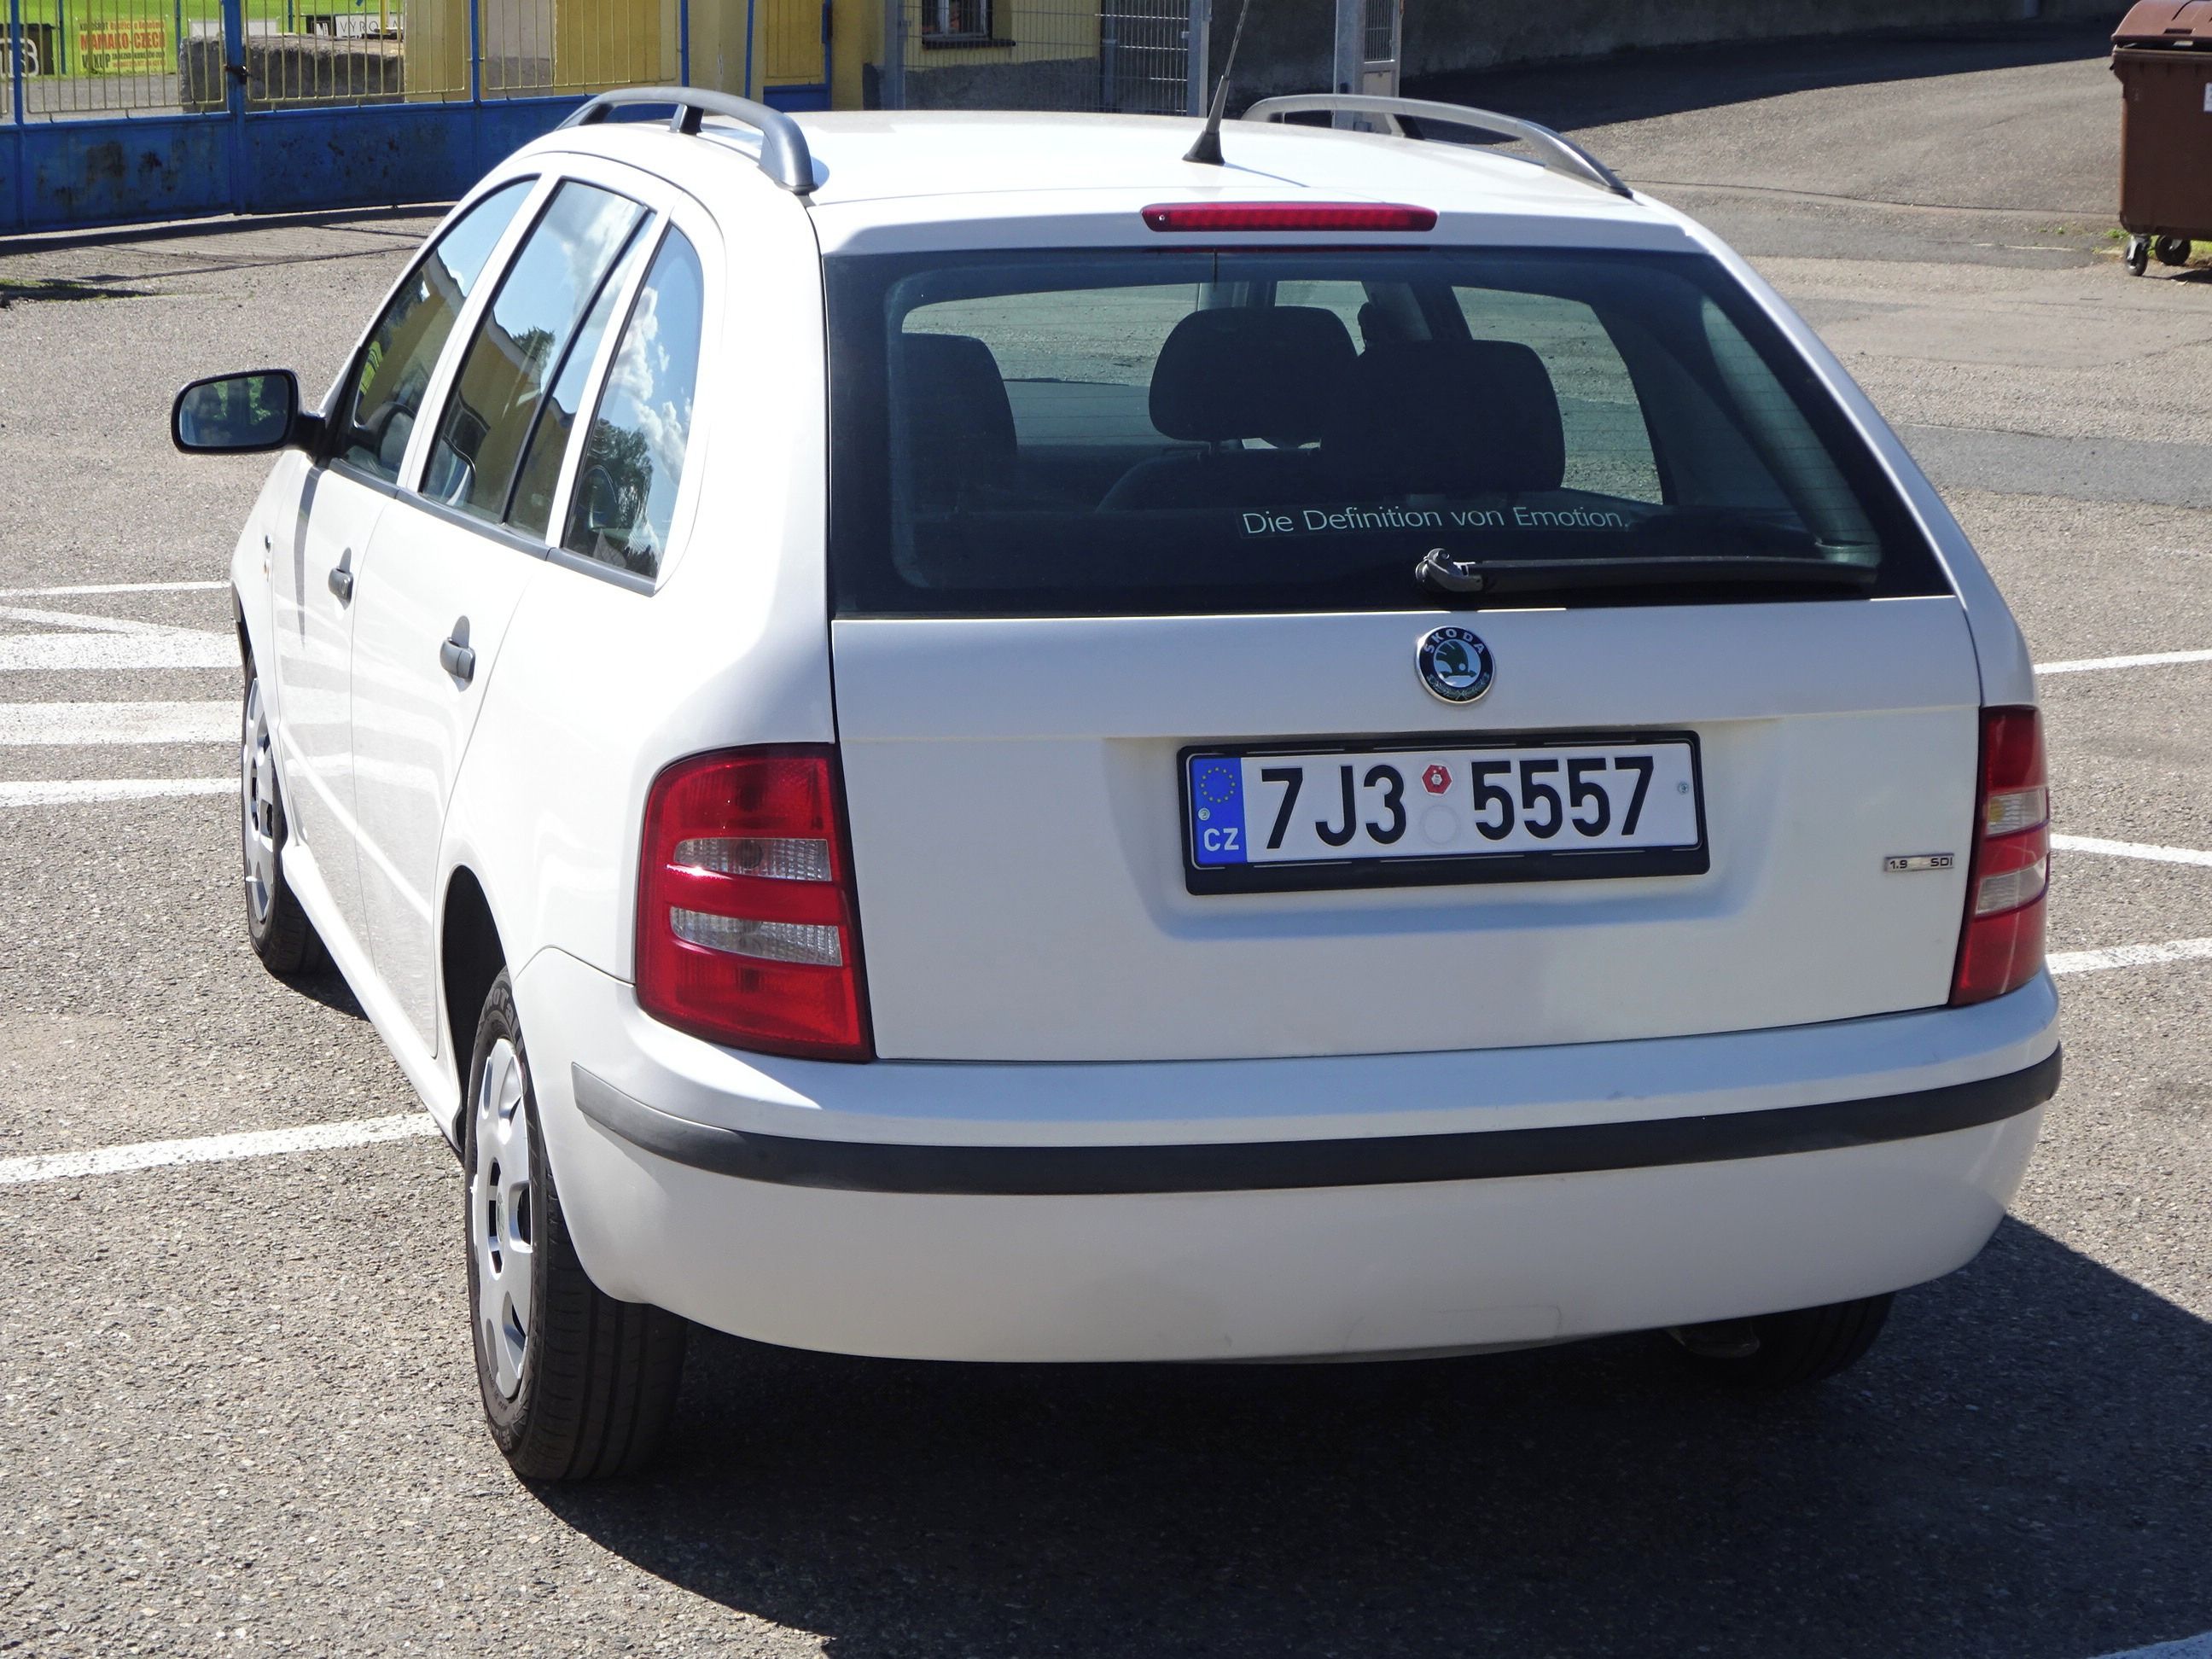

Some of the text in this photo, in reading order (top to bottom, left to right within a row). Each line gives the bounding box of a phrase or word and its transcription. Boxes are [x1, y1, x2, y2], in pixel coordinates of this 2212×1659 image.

[1243, 506, 1631, 533] Die Definition von Emotion.
[1260, 756, 1655, 849] 7J3 5557
[1203, 828, 1239, 852] CZ
[1889, 857, 1953, 870] 1.9 SDI
